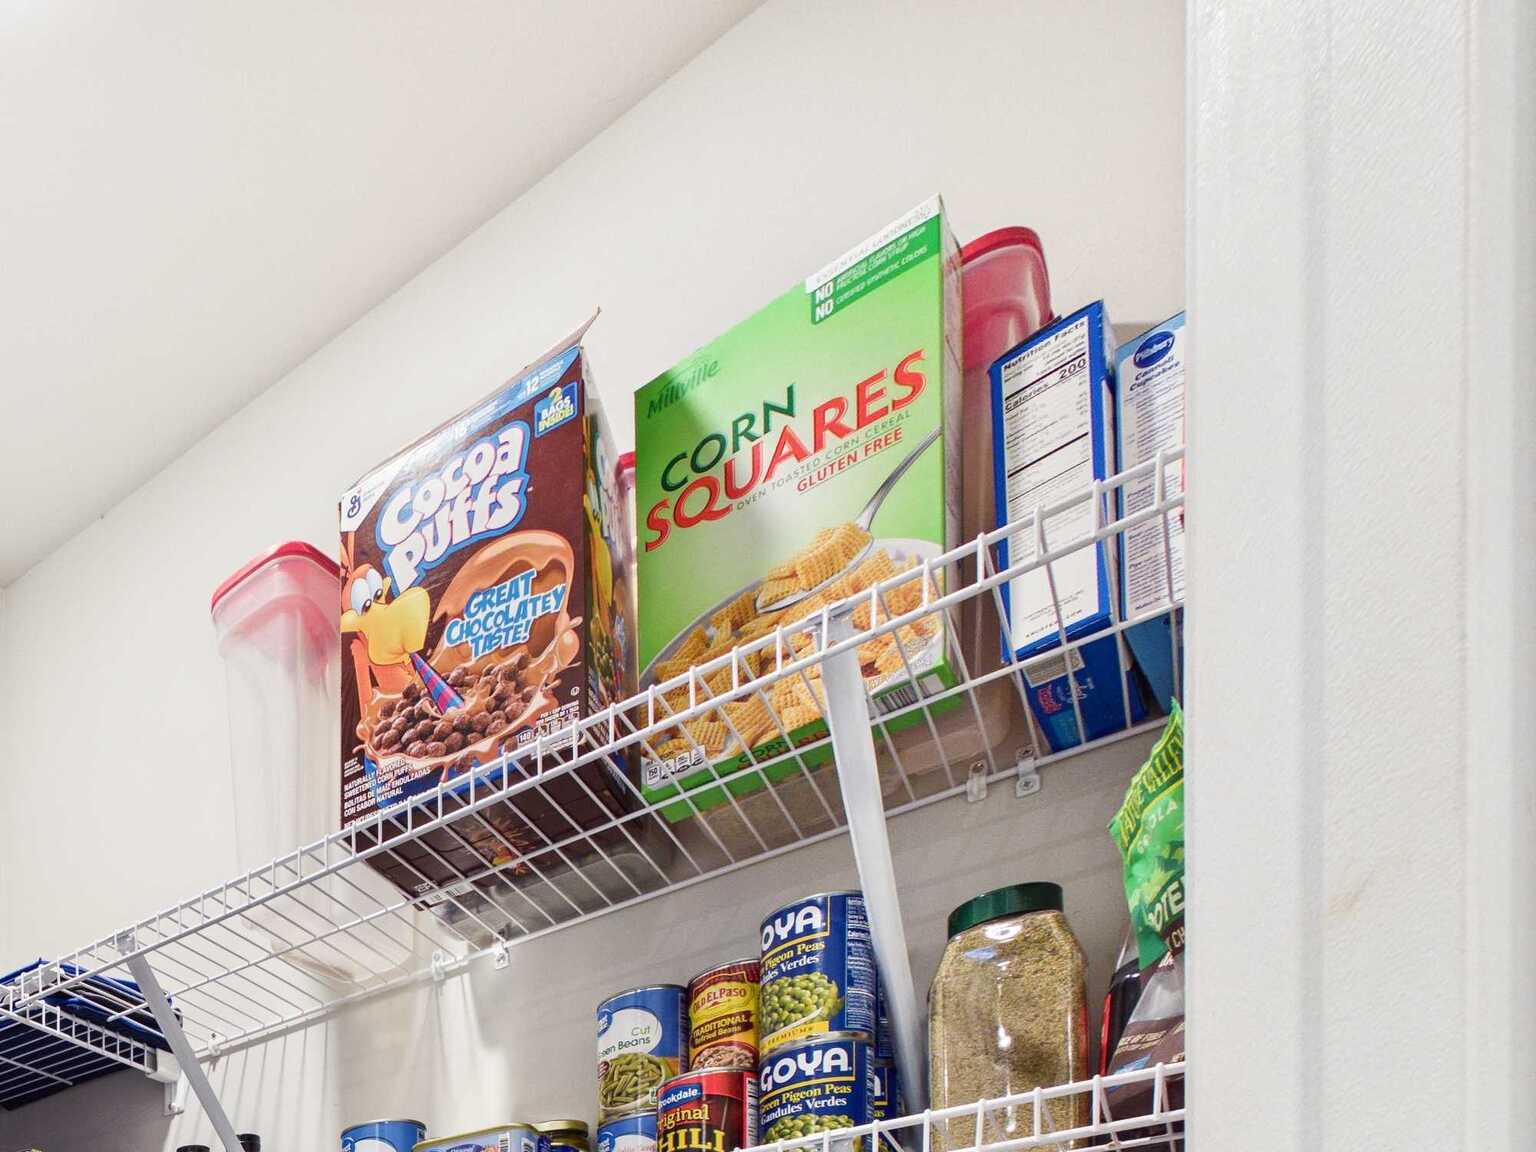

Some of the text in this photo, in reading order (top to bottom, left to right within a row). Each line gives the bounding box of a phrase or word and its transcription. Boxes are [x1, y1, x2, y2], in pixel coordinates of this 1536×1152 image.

[815, 282, 834, 303] NO
[815, 299, 834, 321] NO
[1003, 341, 1052, 371] Nutrition
[1054, 320, 1086, 342] Facts
[647, 358, 720, 420] Millville
[1005, 383, 1050, 412] Calories
[1058, 357, 1087, 380] 200
[541, 395, 572, 420] BAGS
[644, 348, 927, 553] SQUARES
[660, 383, 797, 493] CORN
[796, 426, 904, 493] GLUTEN FREE
[736, 409, 912, 511] OVEN TOASTED CORN CEREAL
[379, 426, 525, 547] Cocoa
[386, 474, 524, 594] Puffs
[465, 569, 535, 618] GREAT
[444, 584, 567, 647] CHOCOLATEY
[470, 620, 531, 660] TASTE!
[761, 905, 823, 952] OYA
[797, 940, 826, 955] Peas
[780, 953, 821, 972] Verdes
[617, 1036, 652, 1051] Beans
[630, 1025, 651, 1038] Cut
[692, 1013, 748, 1038] TRADITIONAL
[760, 1046, 849, 1093] GOYA
[657, 1103, 710, 1130] riginal
[658, 1086, 699, 1111] rookdale
[760, 1083, 852, 1113] reen Pigeon Peas
[804, 1096, 848, 1111] Verdes
